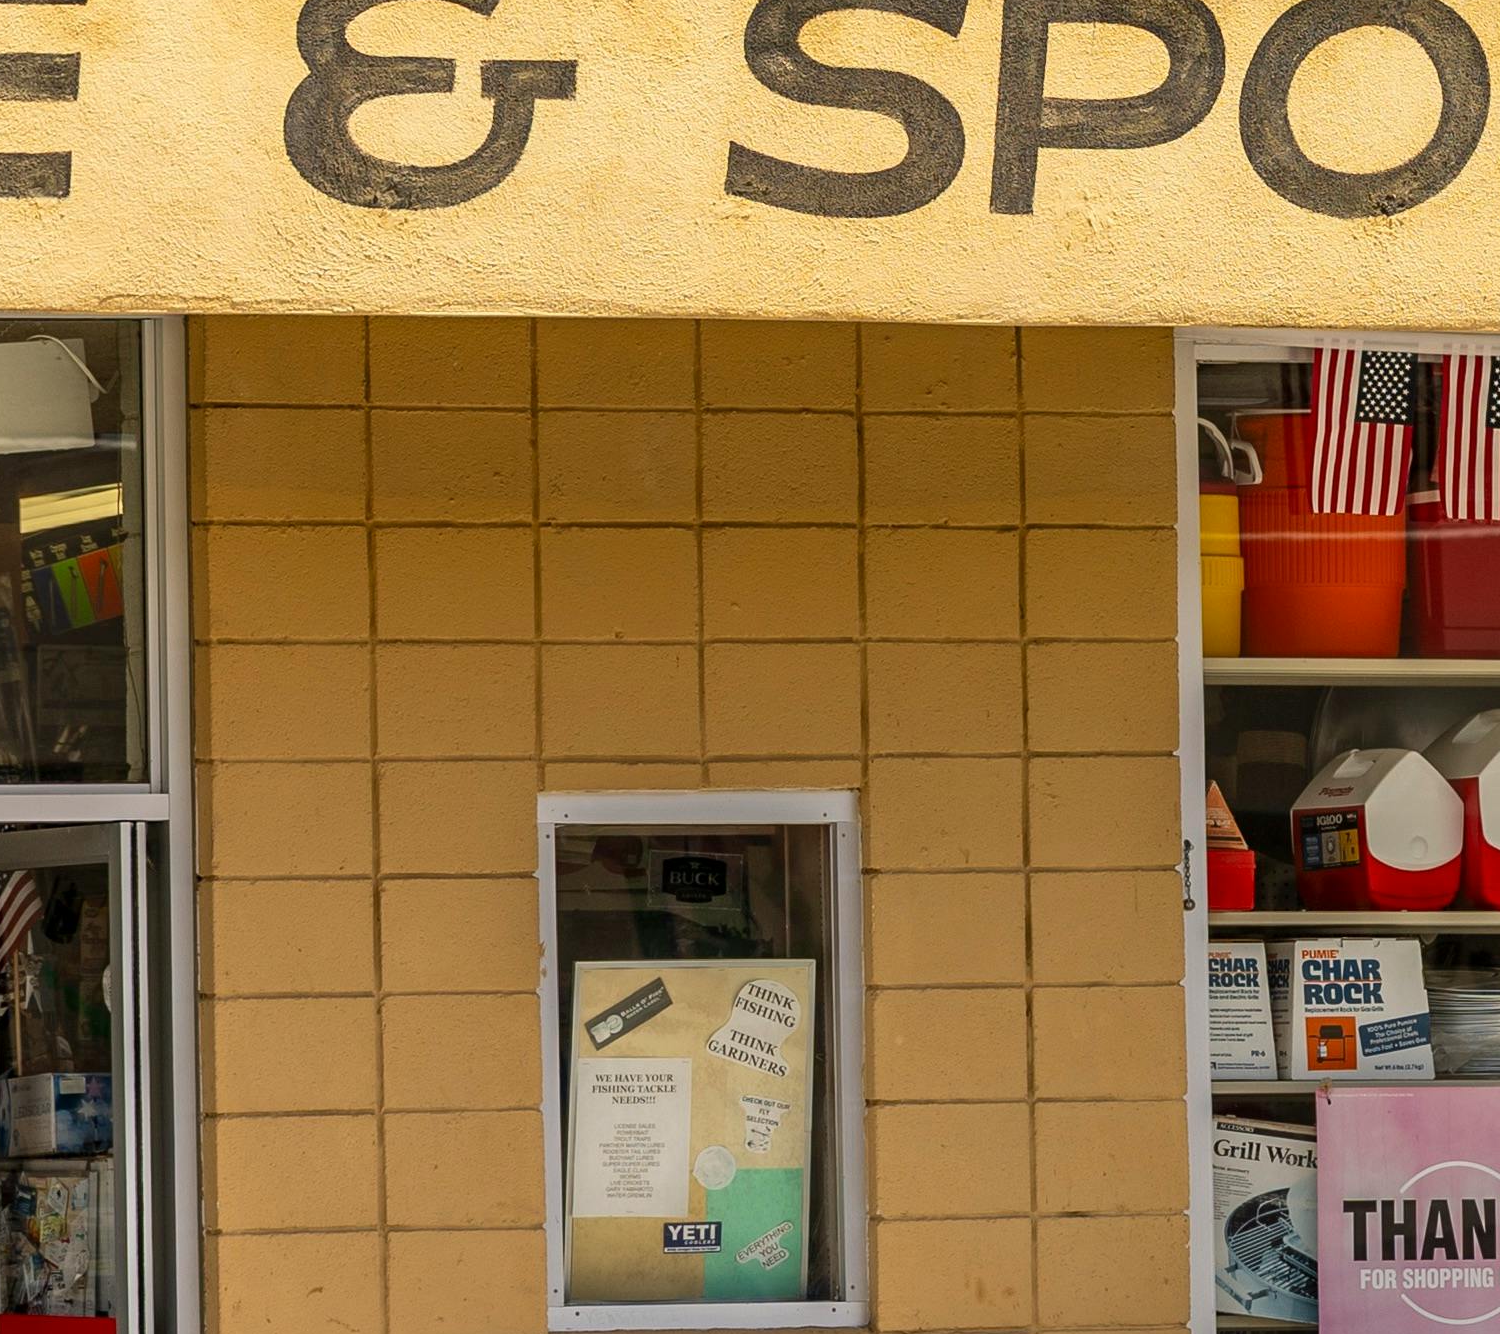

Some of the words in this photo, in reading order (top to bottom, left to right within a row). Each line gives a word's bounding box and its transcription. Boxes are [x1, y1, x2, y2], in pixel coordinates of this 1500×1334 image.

[669, 870, 721, 887] BUCK
[1208, 958, 1259, 973] CHAR
[1301, 958, 1382, 982] CHAR
[1208, 973, 1261, 988] ROCK
[746, 982, 796, 1012] THINK
[1303, 981, 1385, 1005] ROCK
[734, 996, 797, 1029] FISHING
[729, 1028, 780, 1058] THINK
[707, 1039, 788, 1078] GARDNERS
[591, 1084, 636, 1094] FISHING
[637, 1084, 677, 1094] TACKLE
[595, 1074, 612, 1083] WE
[615, 1074, 644, 1083] HAVE
[645, 1073, 675, 1083] YOUR
[1213, 1138, 1262, 1162] Grill
[667, 1224, 717, 1240] YETI
[737, 1223, 792, 1261] EVERYTHING
[759, 1242, 780, 1258] YOU
[761, 1249, 787, 1269] NEED
[1359, 1268, 1398, 1291] FOR
[1403, 1267, 1495, 1291] SHOPPING
